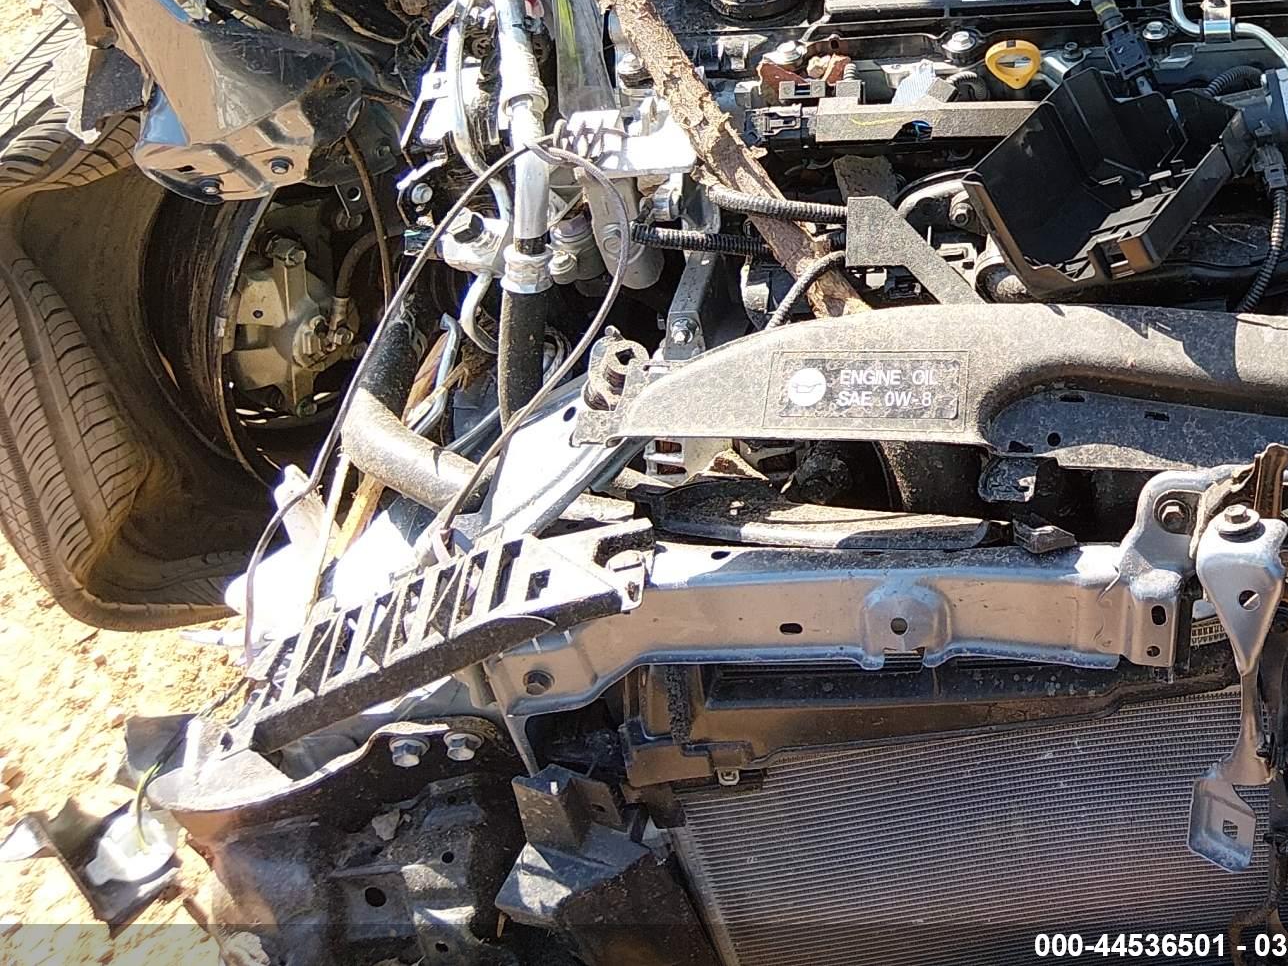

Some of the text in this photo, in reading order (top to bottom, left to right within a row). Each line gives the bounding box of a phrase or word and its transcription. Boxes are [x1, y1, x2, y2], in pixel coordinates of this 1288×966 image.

[839, 369, 938, 386] ENGINE OIL
[837, 390, 873, 407] SAE
